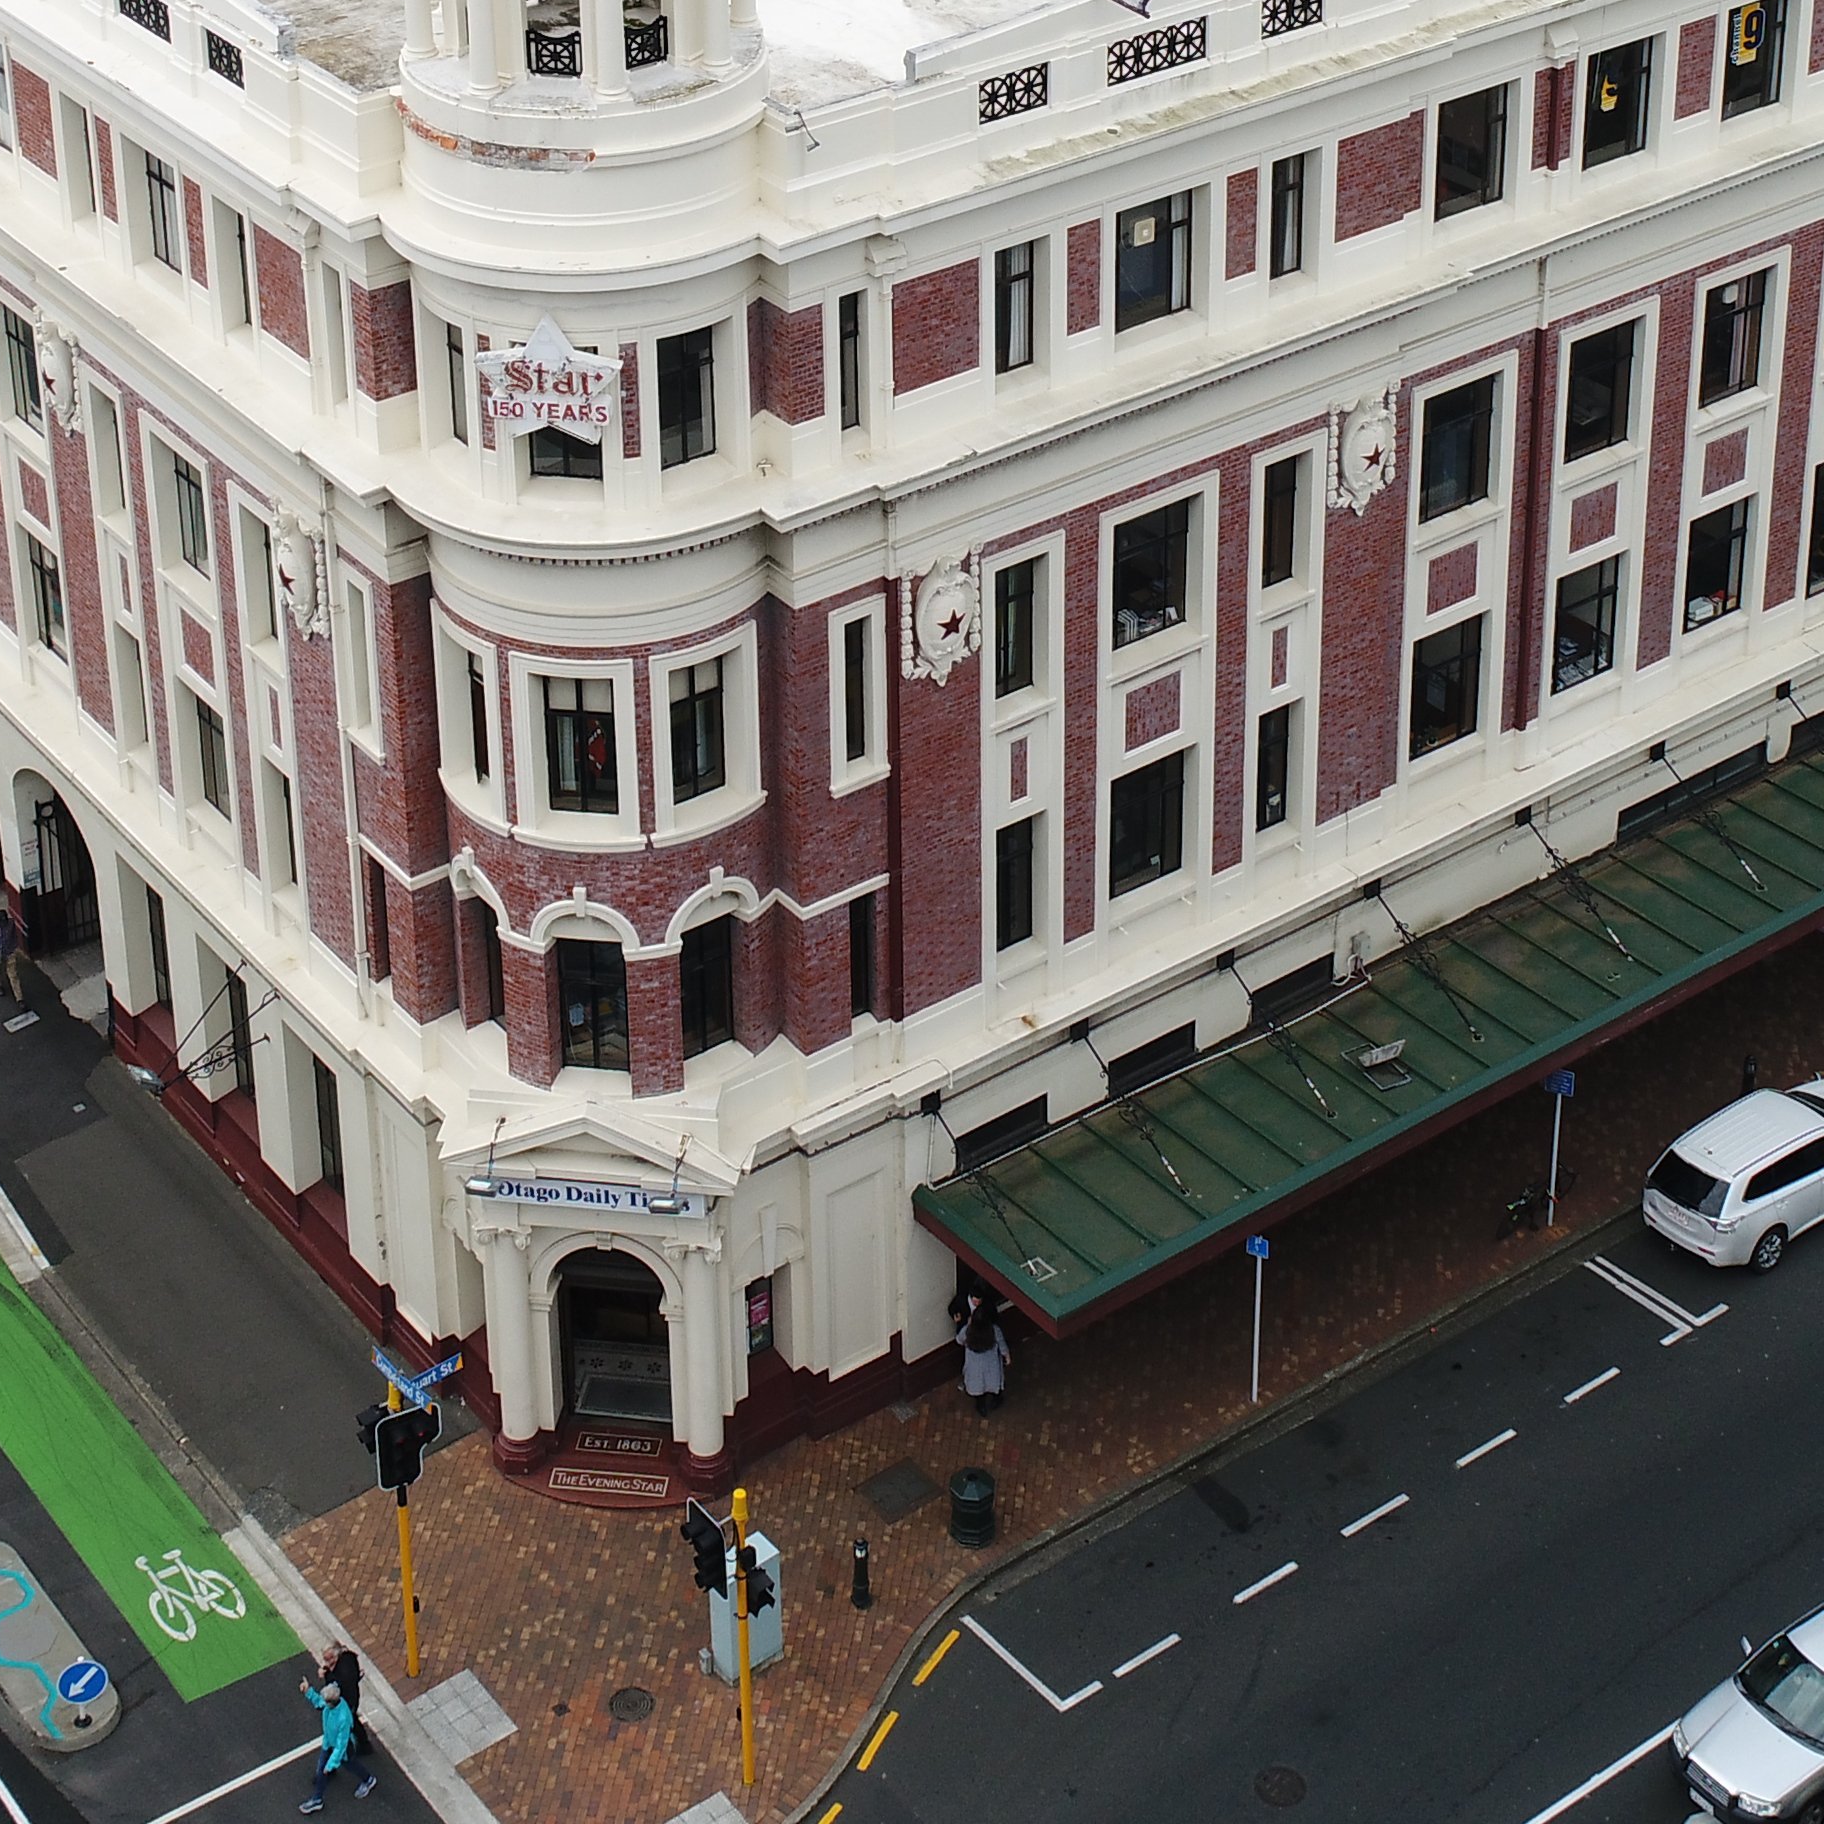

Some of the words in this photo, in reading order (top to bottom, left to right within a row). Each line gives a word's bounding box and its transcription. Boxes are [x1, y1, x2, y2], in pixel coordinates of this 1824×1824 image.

[504, 359, 604, 396] Star
[493, 400, 524, 418] 150
[532, 402, 608, 423] YEARS
[498, 1181, 560, 1202] Otago
[566, 1186, 621, 1208] Daily
[625, 1191, 691, 1212] Tis
[411, 1369, 438, 1390] uart
[440, 1361, 453, 1377] St
[616, 1439, 651, 1452] 1863
[556, 1472, 579, 1486] THE
[578, 1474, 630, 1489] EVENING
[630, 1479, 664, 1492] STAR
